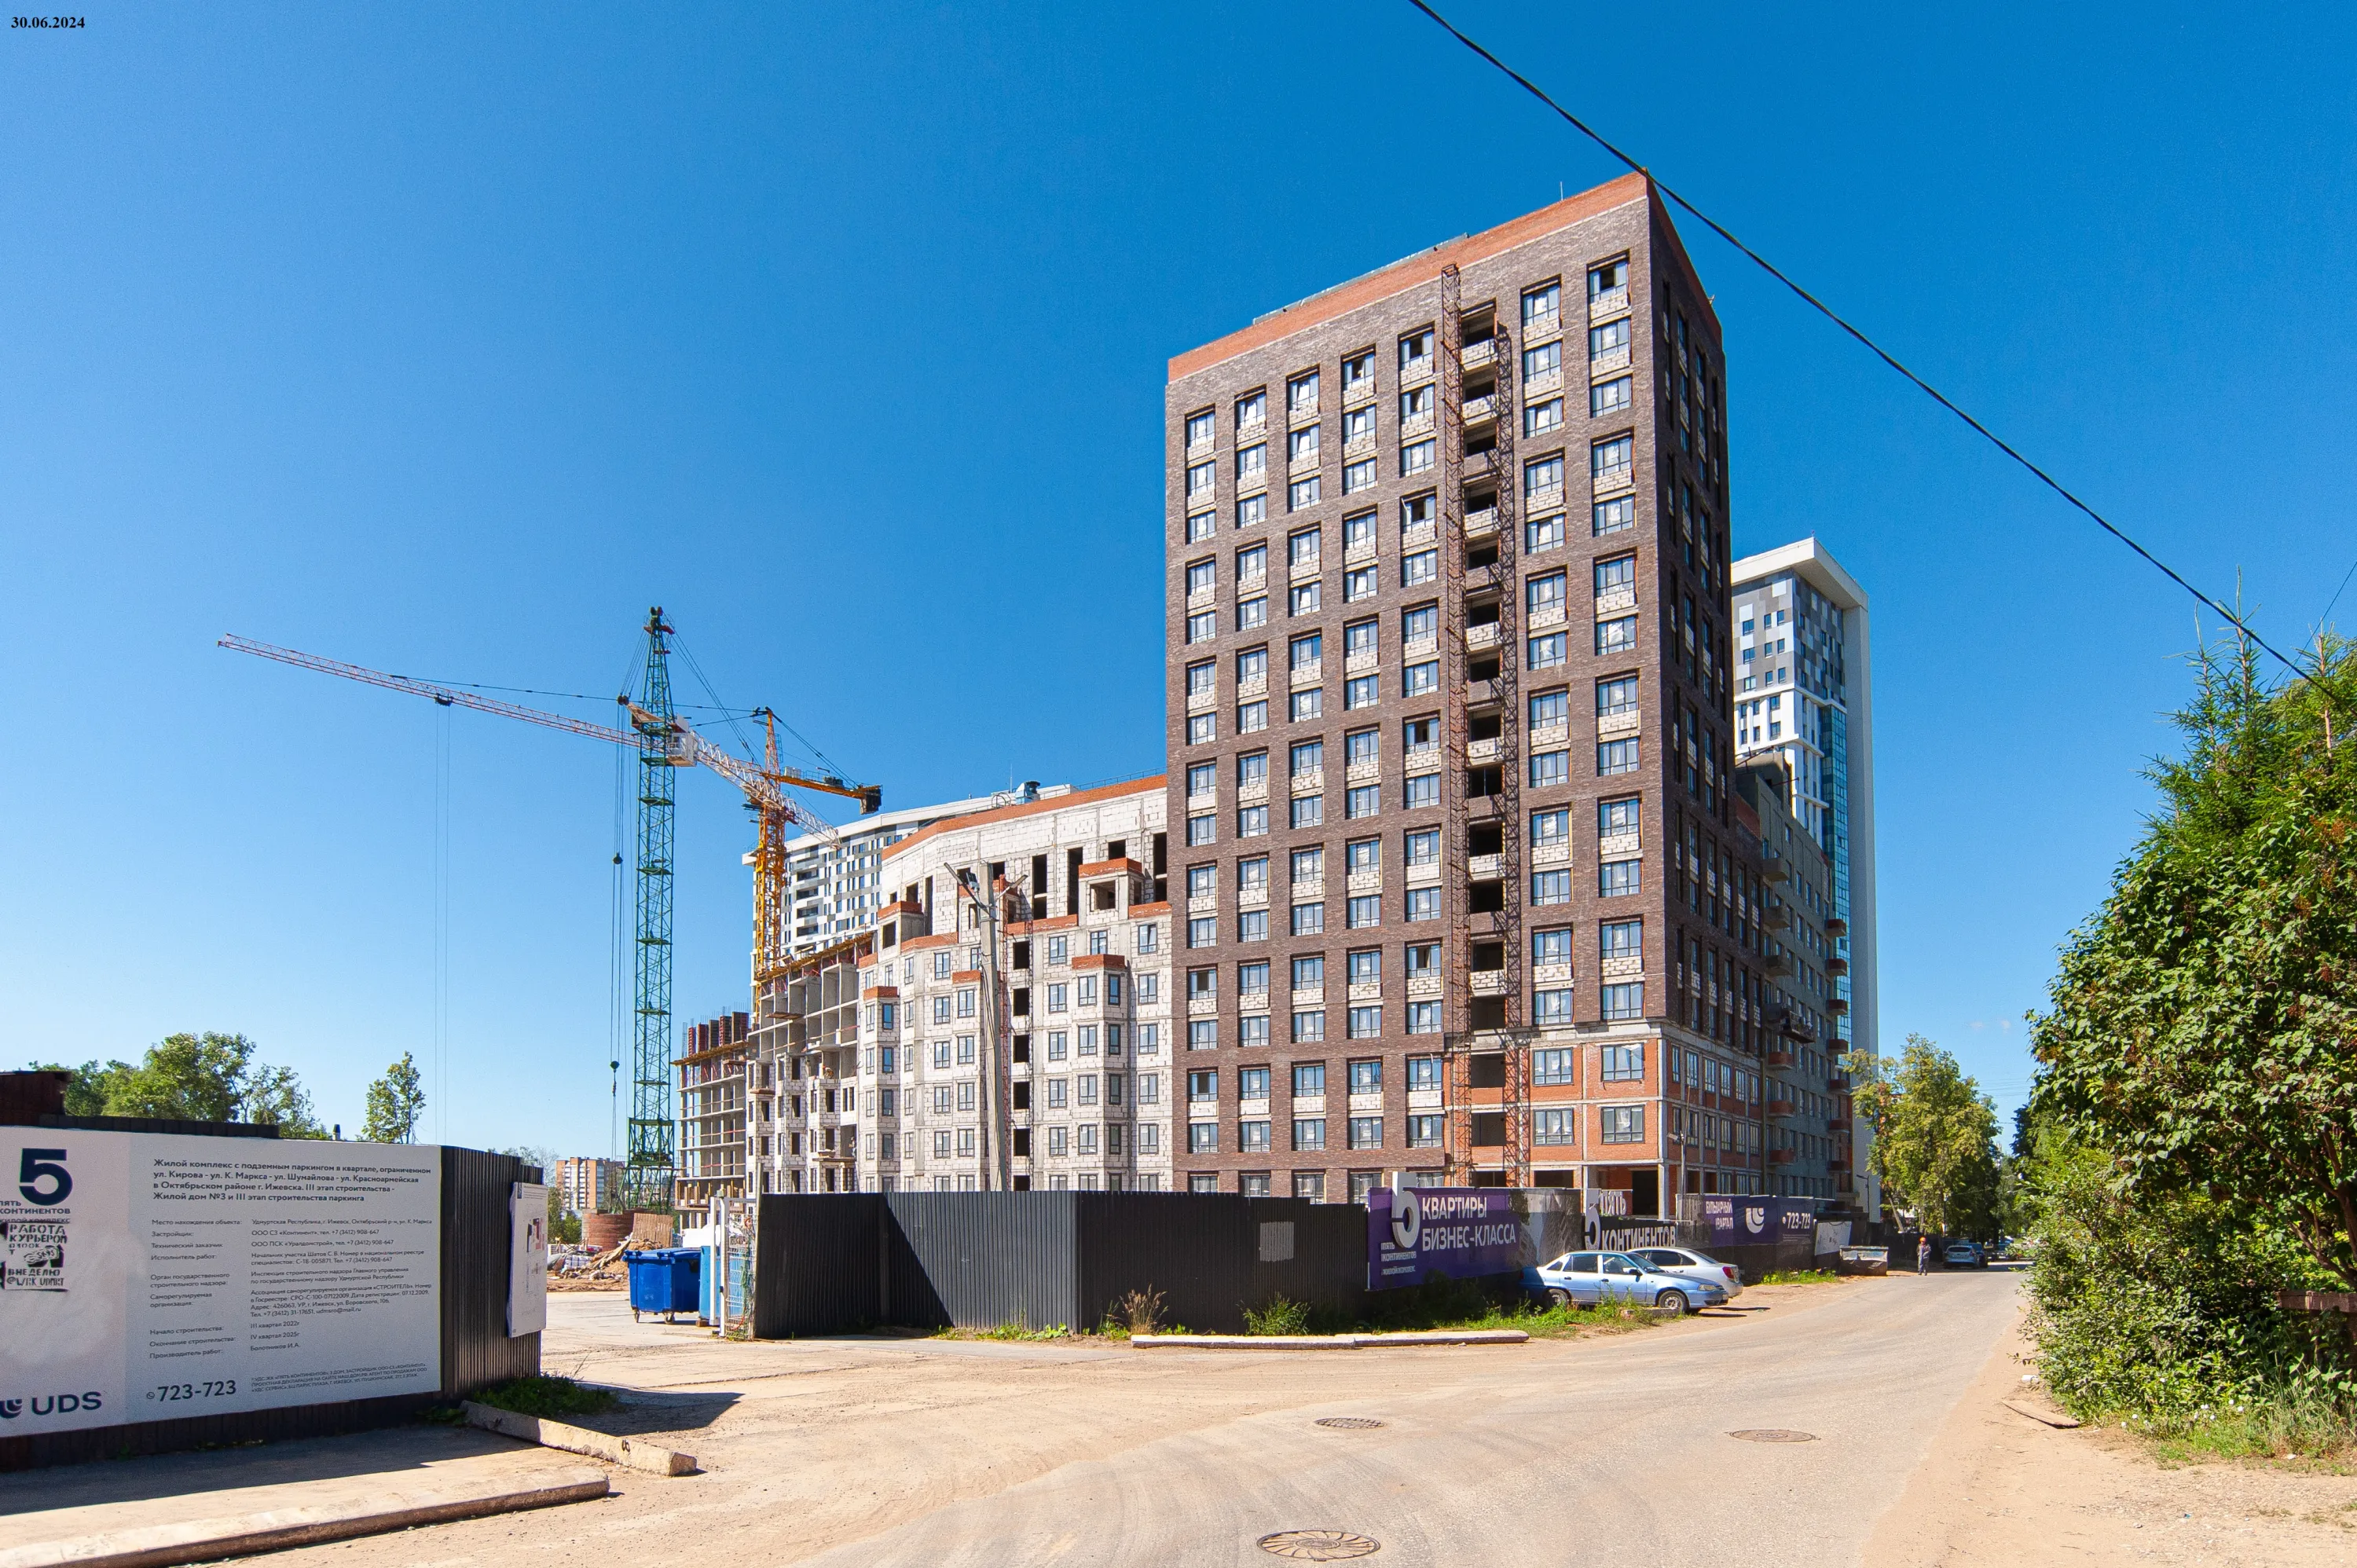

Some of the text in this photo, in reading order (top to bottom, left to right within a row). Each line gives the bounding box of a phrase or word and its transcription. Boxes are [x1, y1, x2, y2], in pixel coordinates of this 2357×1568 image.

[154, 1159, 187, 1167] Жилой
[19, 1148, 73, 1206] 5
[161, 1181, 222, 1190] Октябрьском
[1392, 1171, 1420, 1248] 5
[1422, 1197, 1487, 1220] КВАРТИРЫ
[1600, 1190, 1626, 1215] ПЯТЬ
[9, 1225, 65, 1234] РАБОТА
[1787, 1212, 1810, 1229] 723-723
[1422, 1223, 1516, 1251] БИЗНЕС-КЛАССА
[1602, 1226, 1676, 1251] КОНТИНЕНТОВ
[158, 1379, 236, 1401] 723-723
[31, 1391, 102, 1415] UDS
